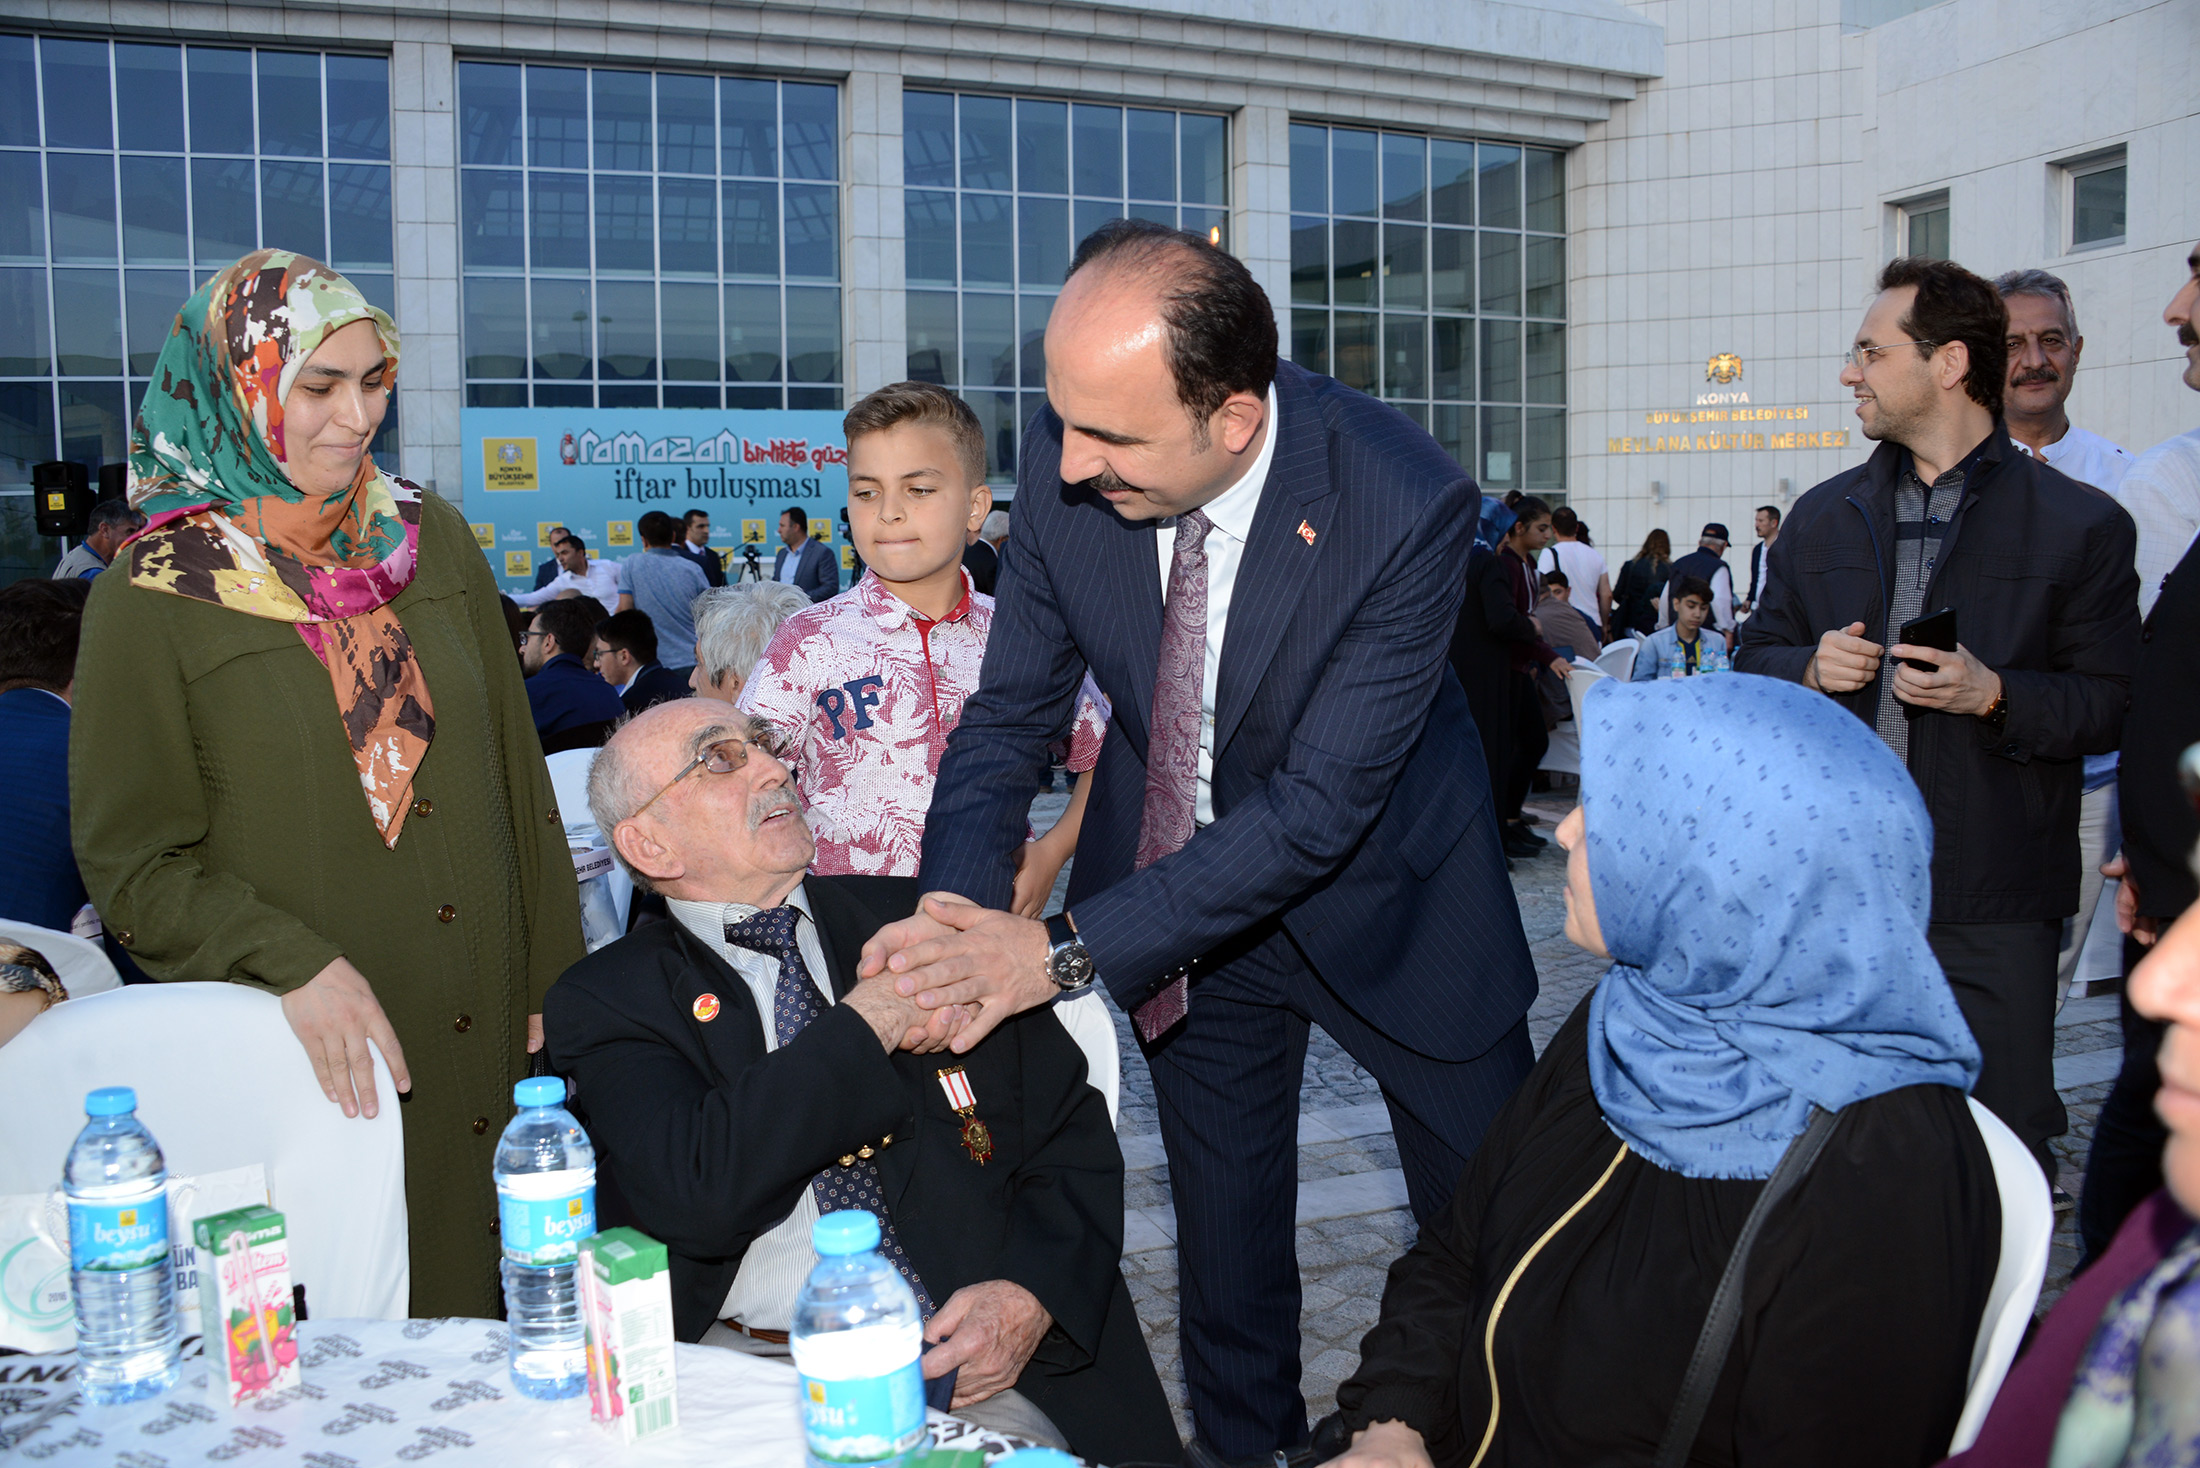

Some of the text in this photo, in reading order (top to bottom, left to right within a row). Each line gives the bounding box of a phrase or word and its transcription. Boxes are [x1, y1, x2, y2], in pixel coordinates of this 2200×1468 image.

[1696, 391, 1750, 405] KONYA
[1646, 405, 1809, 424] BÜYÜKŞEHİR BELEDİYESİ
[1608, 426, 1851, 453] MEVLANA KÜLTÜR MERKEZİ
[743, 438, 808, 468] birlikte
[810, 445, 849, 471] güz
[614, 467, 823, 506] iftar buluşması
[816, 674, 884, 740] PF
[93, 1222, 151, 1249] beysu
[543, 1211, 593, 1238] beysu
